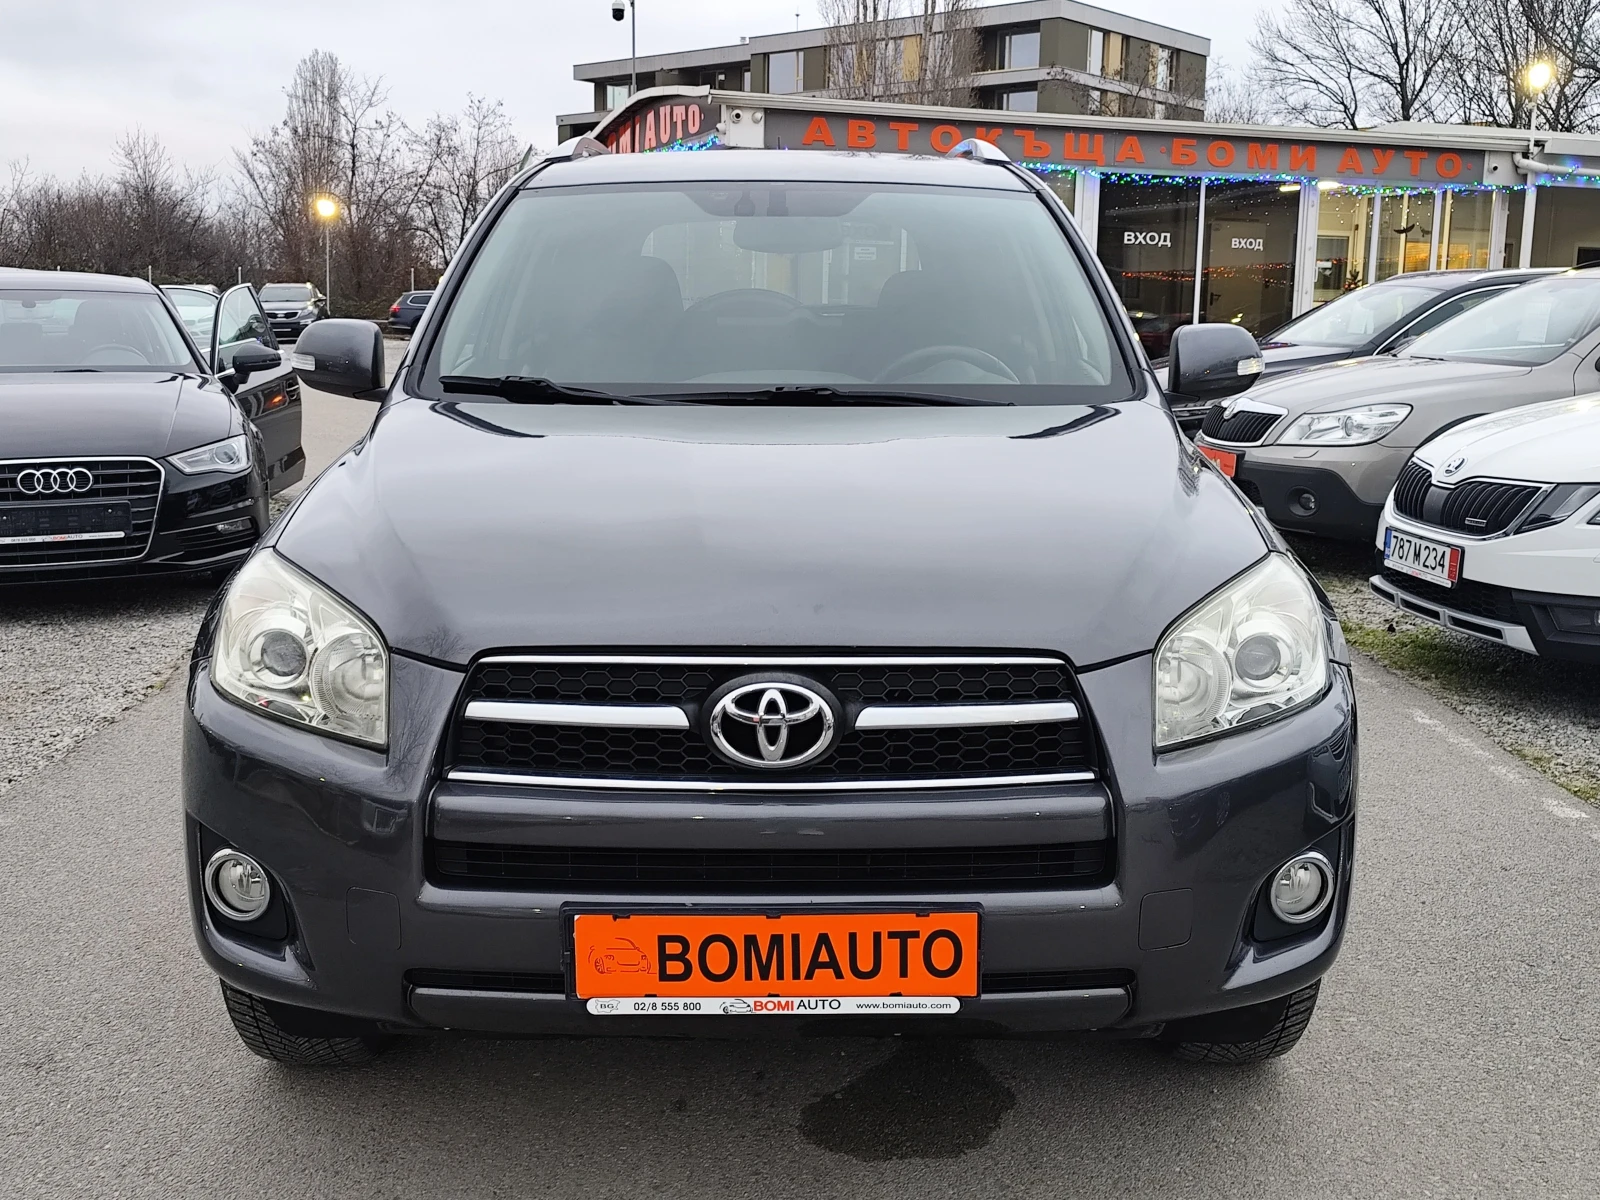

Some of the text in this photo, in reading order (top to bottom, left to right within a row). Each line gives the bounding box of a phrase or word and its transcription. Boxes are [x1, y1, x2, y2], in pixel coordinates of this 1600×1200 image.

[1170, 138, 1317, 172] БОМИ
[1337, 147, 1462, 178] АУТО
[1123, 231, 1172, 248] ВХОД
[1231, 237, 1264, 251] ВХОД
[656, 928, 963, 983] BOMIAUTO
[633, 1002, 658, 1012] 02/8
[660, 1002, 680, 1011] 555
[682, 1002, 702, 1011] 800
[753, 1000, 794, 1012] BOMI
[796, 999, 842, 1010] AUTO
[855, 1001, 952, 1009] www.bomiauto.com
